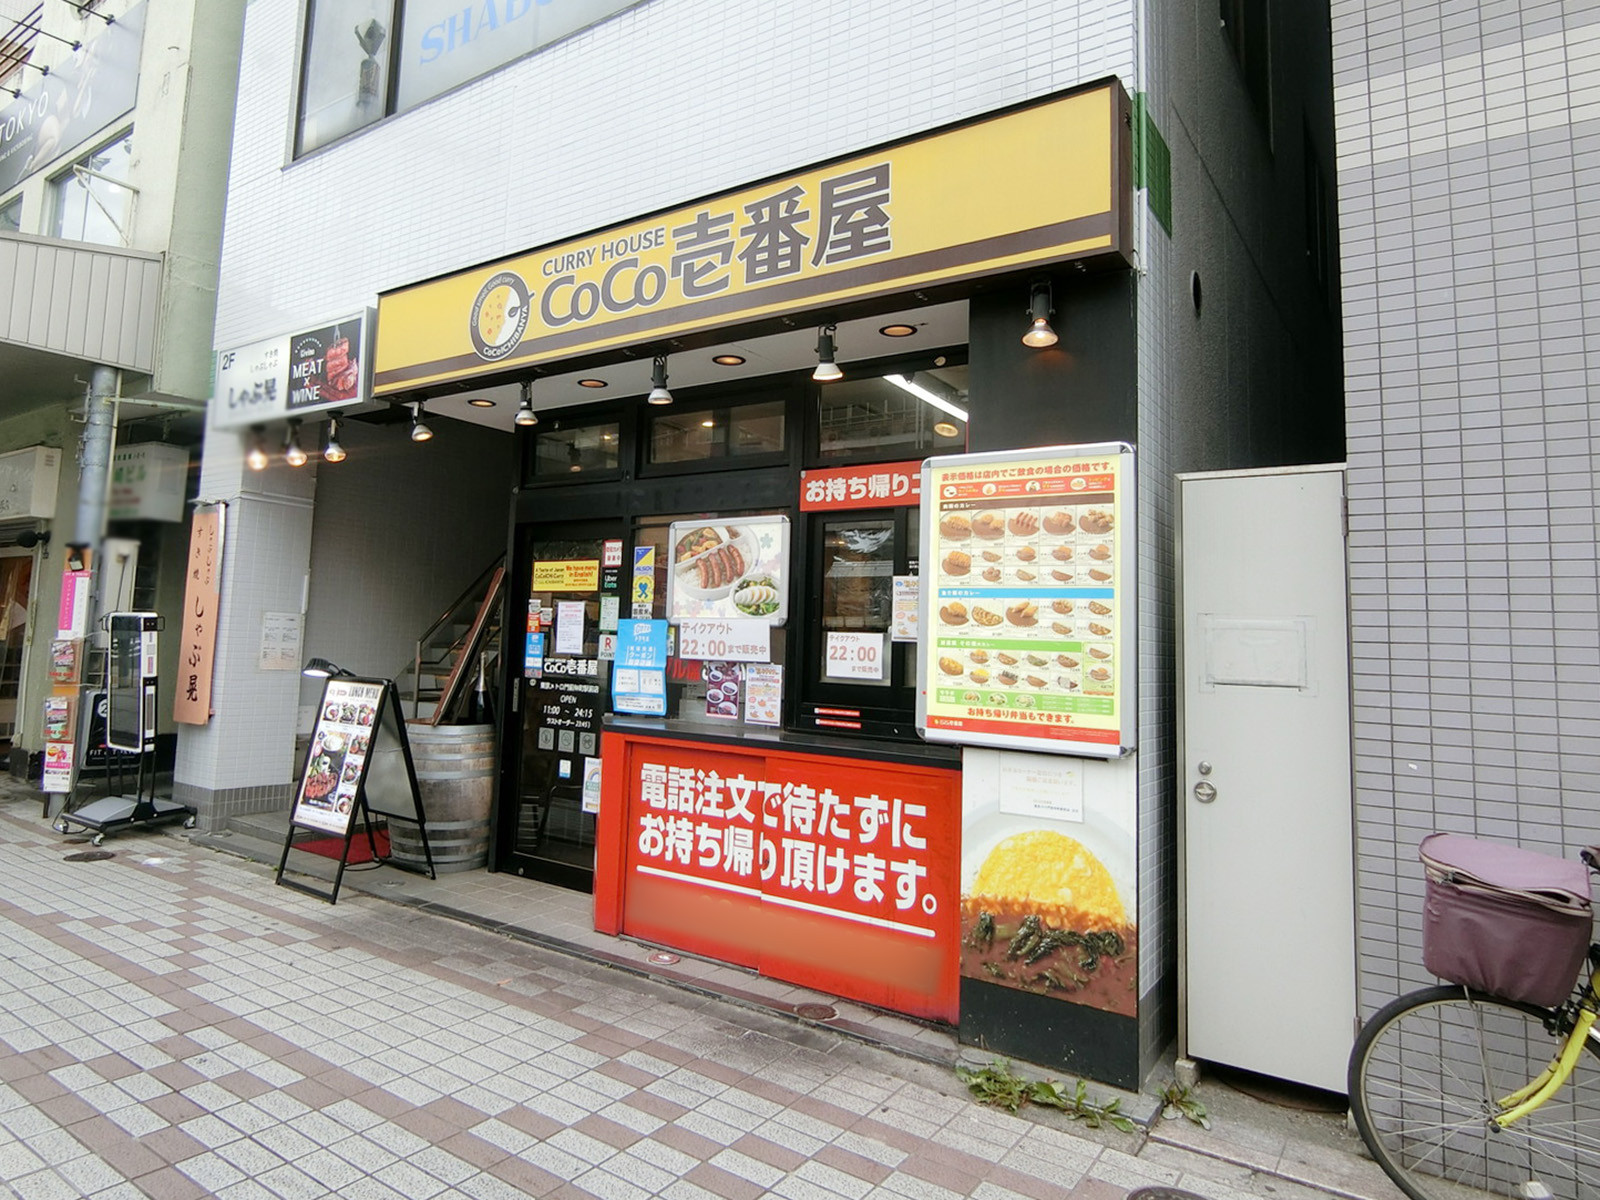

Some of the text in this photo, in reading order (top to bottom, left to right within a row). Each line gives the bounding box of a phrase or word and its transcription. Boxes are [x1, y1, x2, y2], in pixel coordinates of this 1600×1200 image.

[419, 0, 555, 65] SHAB
[540, 162, 893, 328] CoCo壱番屋
[542, 227, 666, 277] CURRY HOUSE
[222, 352, 236, 371] 2F
[292, 358, 324, 379] MEAT
[292, 385, 321, 404] WINE
[681, 622, 732, 634] テイクアウト
[829, 645, 877, 662] 22:00
[560, 694, 577, 704] OPEN
[542, 705, 561, 715] 11:00
[574, 707, 593, 719] 24:15
[967, 707, 1075, 724] お持ち帰り弁当もできます。
[640, 763, 927, 850] 電話注文で待たずに
[638, 813, 938, 915] お持ち帰り頂けます。
